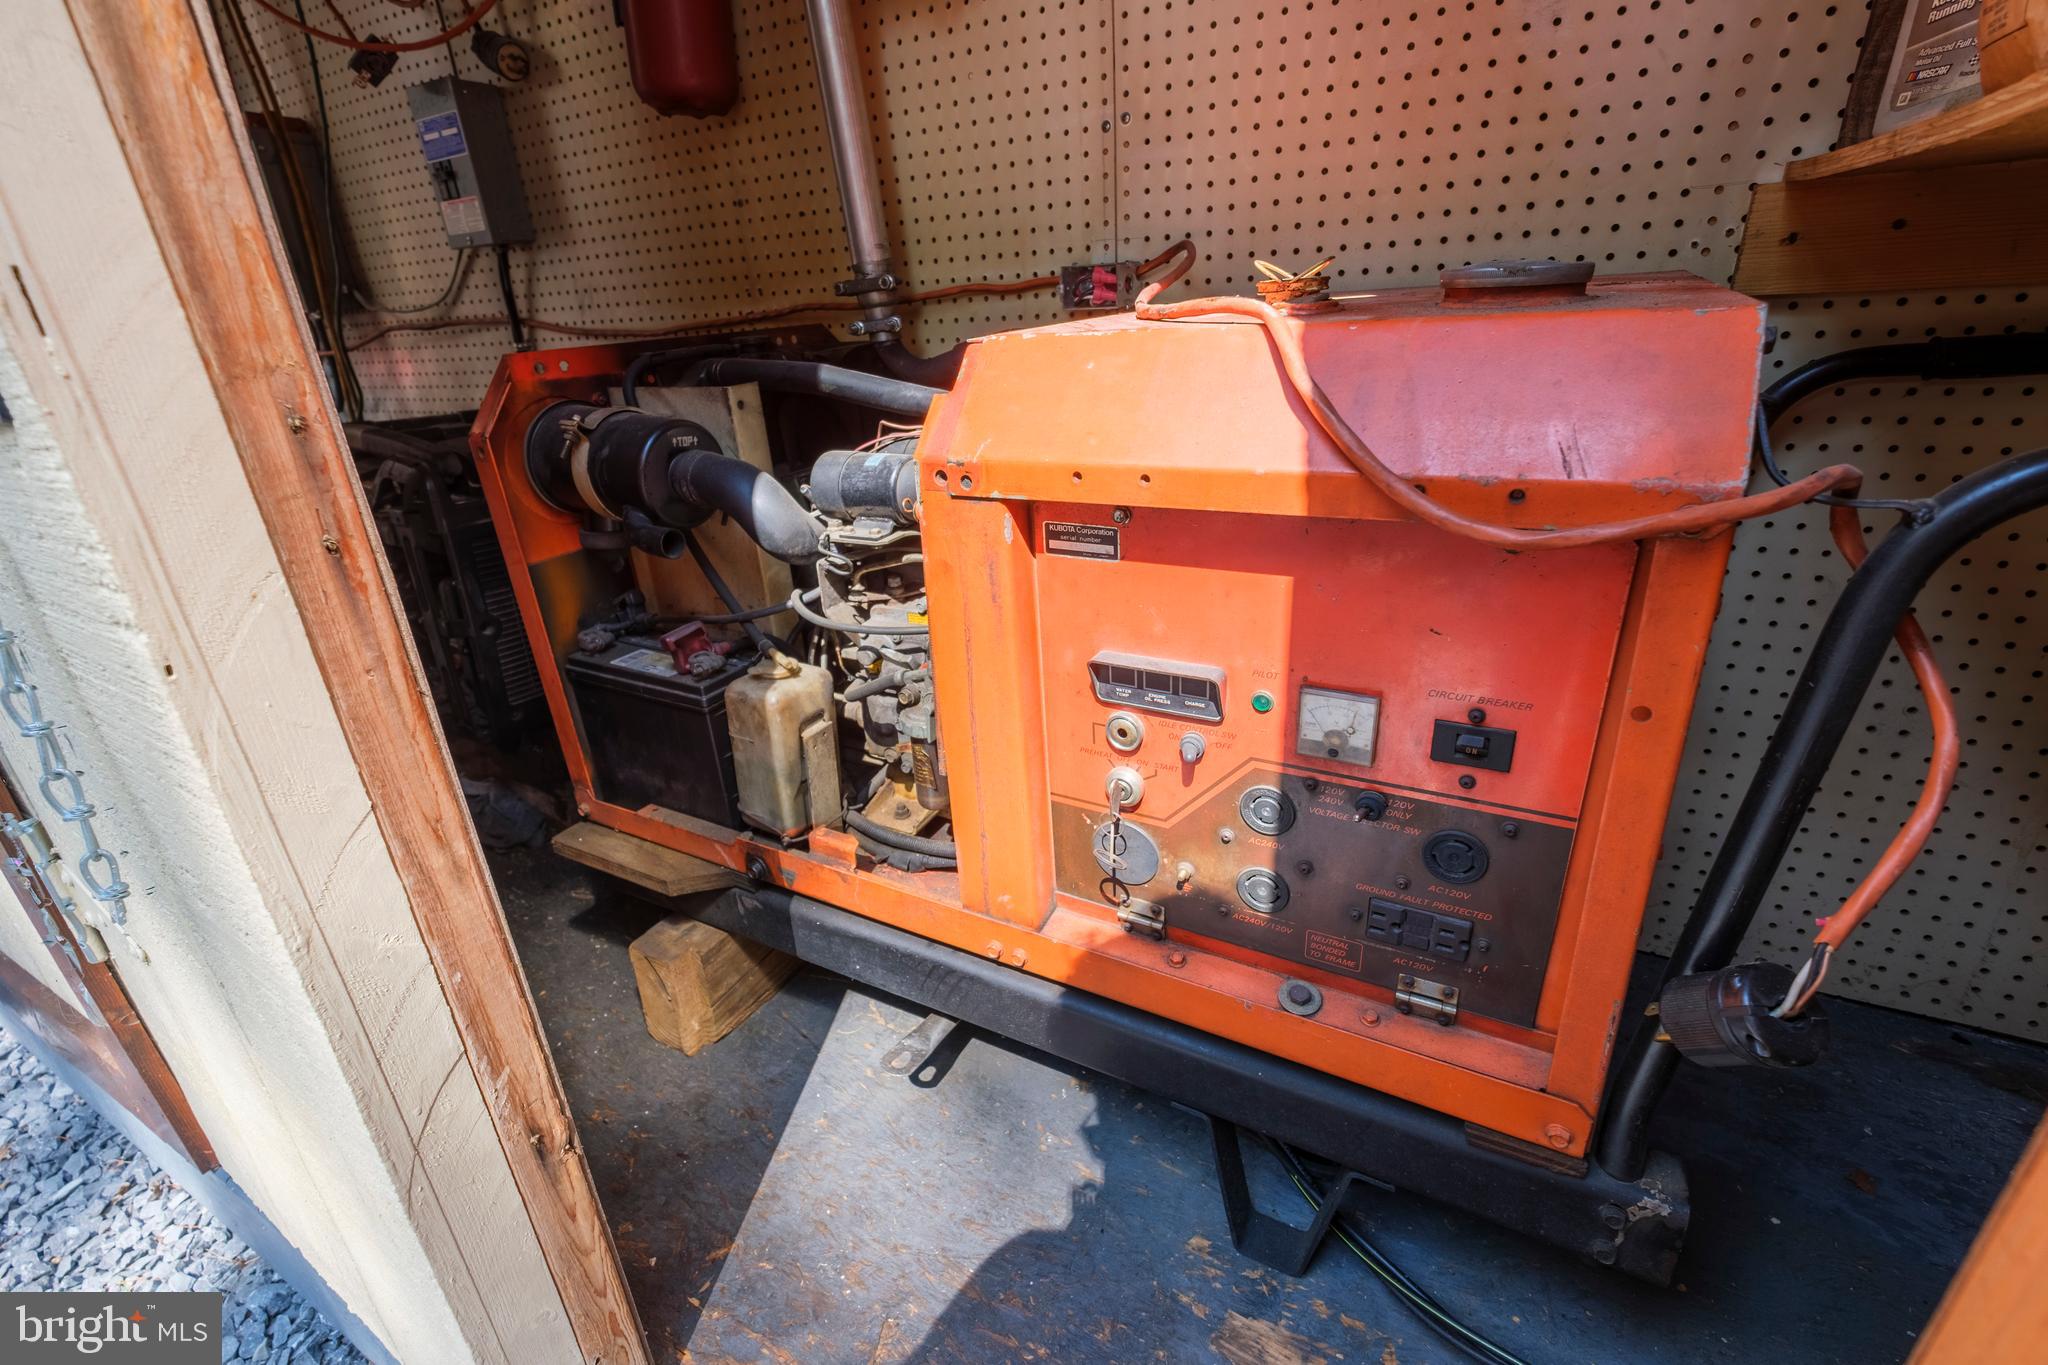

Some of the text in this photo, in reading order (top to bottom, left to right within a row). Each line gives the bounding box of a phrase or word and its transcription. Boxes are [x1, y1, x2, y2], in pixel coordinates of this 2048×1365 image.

[1927, 0, 1977, 24] Running
[1917, 65, 1951, 80] NASCAR
[677, 435, 693, 447] TOP
[1049, 524, 1114, 537] KUBOTA Corporation
[1251, 670, 1281, 681] PILOT
[1184, 700, 1206, 709] CHARGE
[1428, 689, 1534, 712] CIRCUIT BREAKER
[1158, 720, 1179, 731] IDLE
[1465, 746, 1478, 755] ON
[1136, 759, 1149, 768] ON
[1321, 786, 1345, 796] 120V
[1319, 795, 1344, 806] 240V
[1388, 799, 1416, 811] 120V
[1385, 808, 1414, 820] ONLY
[1309, 807, 1351, 821] VOLTAGE
[1403, 826, 1422, 836] SW
[1248, 837, 1286, 850] AC240V
[1428, 884, 1472, 901] AC120V
[1355, 882, 1397, 898] GROUND
[1431, 900, 1493, 922] PROTECTED
[1232, 913, 1294, 934] AC240V/120V
[1311, 934, 1349, 949] NEUTRAL
[1311, 943, 1347, 957] BONDED
[1324, 954, 1358, 968] FRAME
[1393, 957, 1435, 973] AC120V
